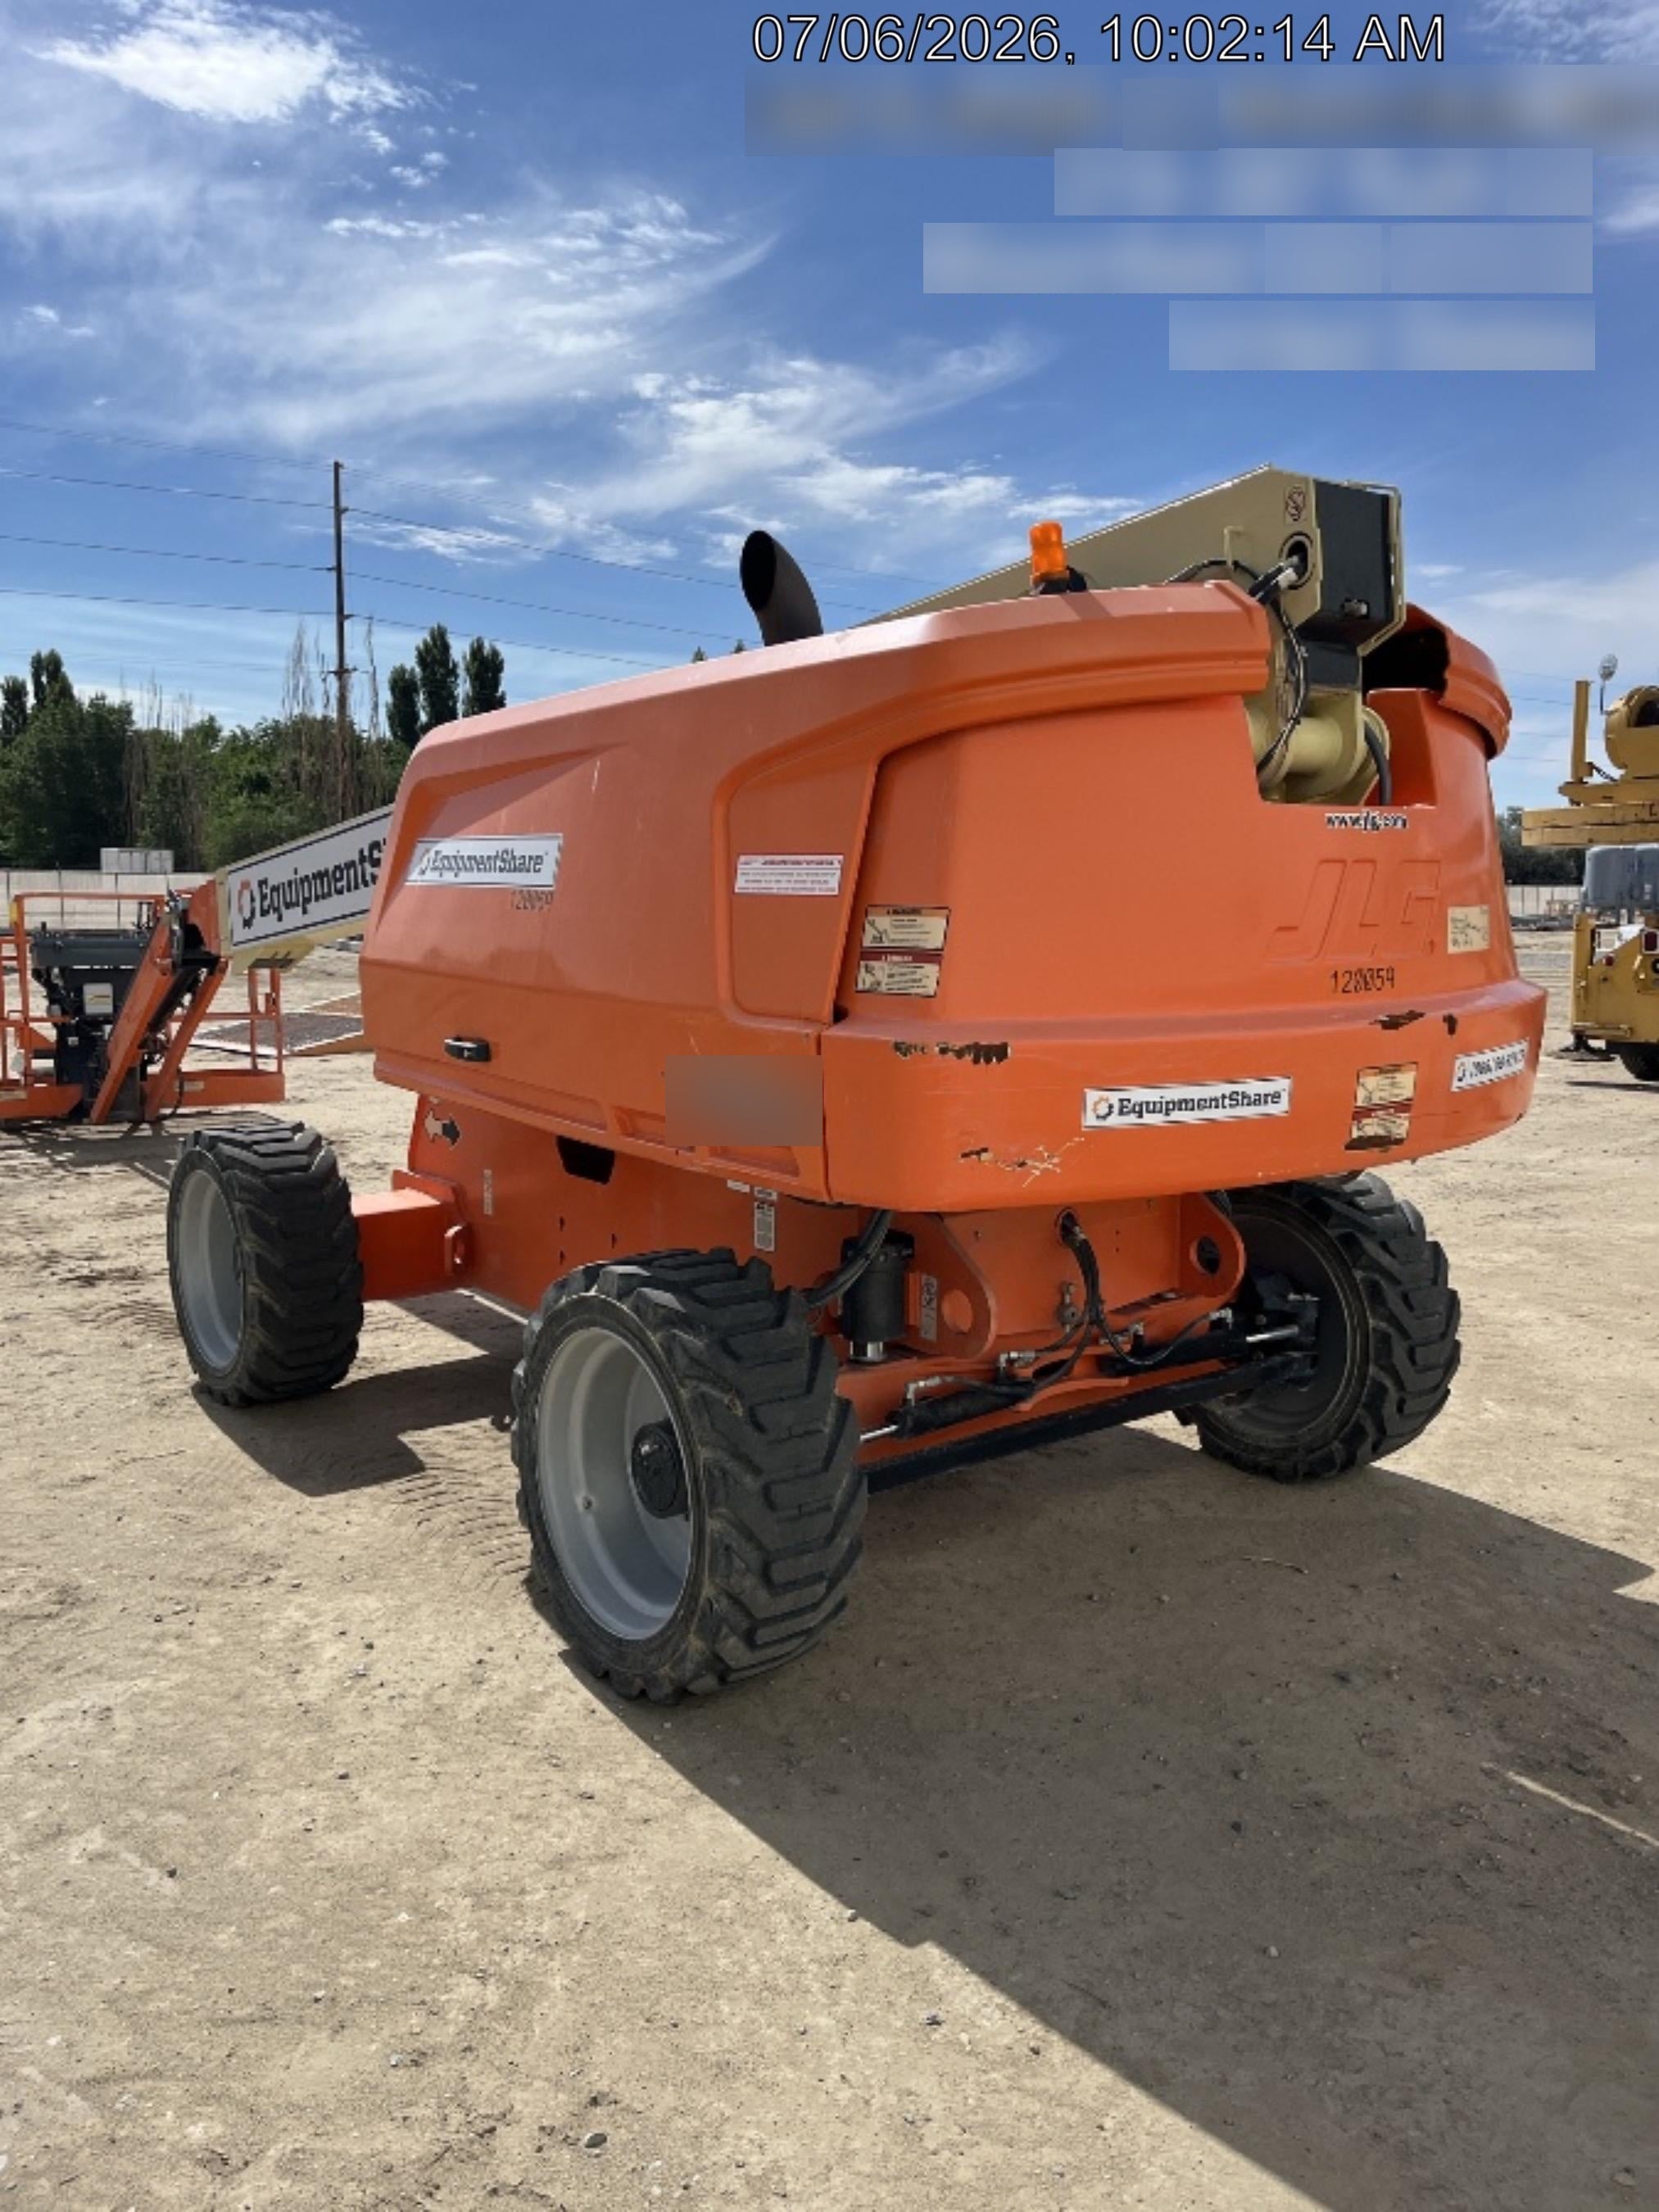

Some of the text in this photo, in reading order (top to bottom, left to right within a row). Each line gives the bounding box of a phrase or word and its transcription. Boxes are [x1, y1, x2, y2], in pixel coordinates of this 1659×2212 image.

[429, 847, 545, 878] EquipmentShare
[257, 837, 387, 922] EquipmentS
[1117, 1090, 1282, 1119] EquipmentShare
